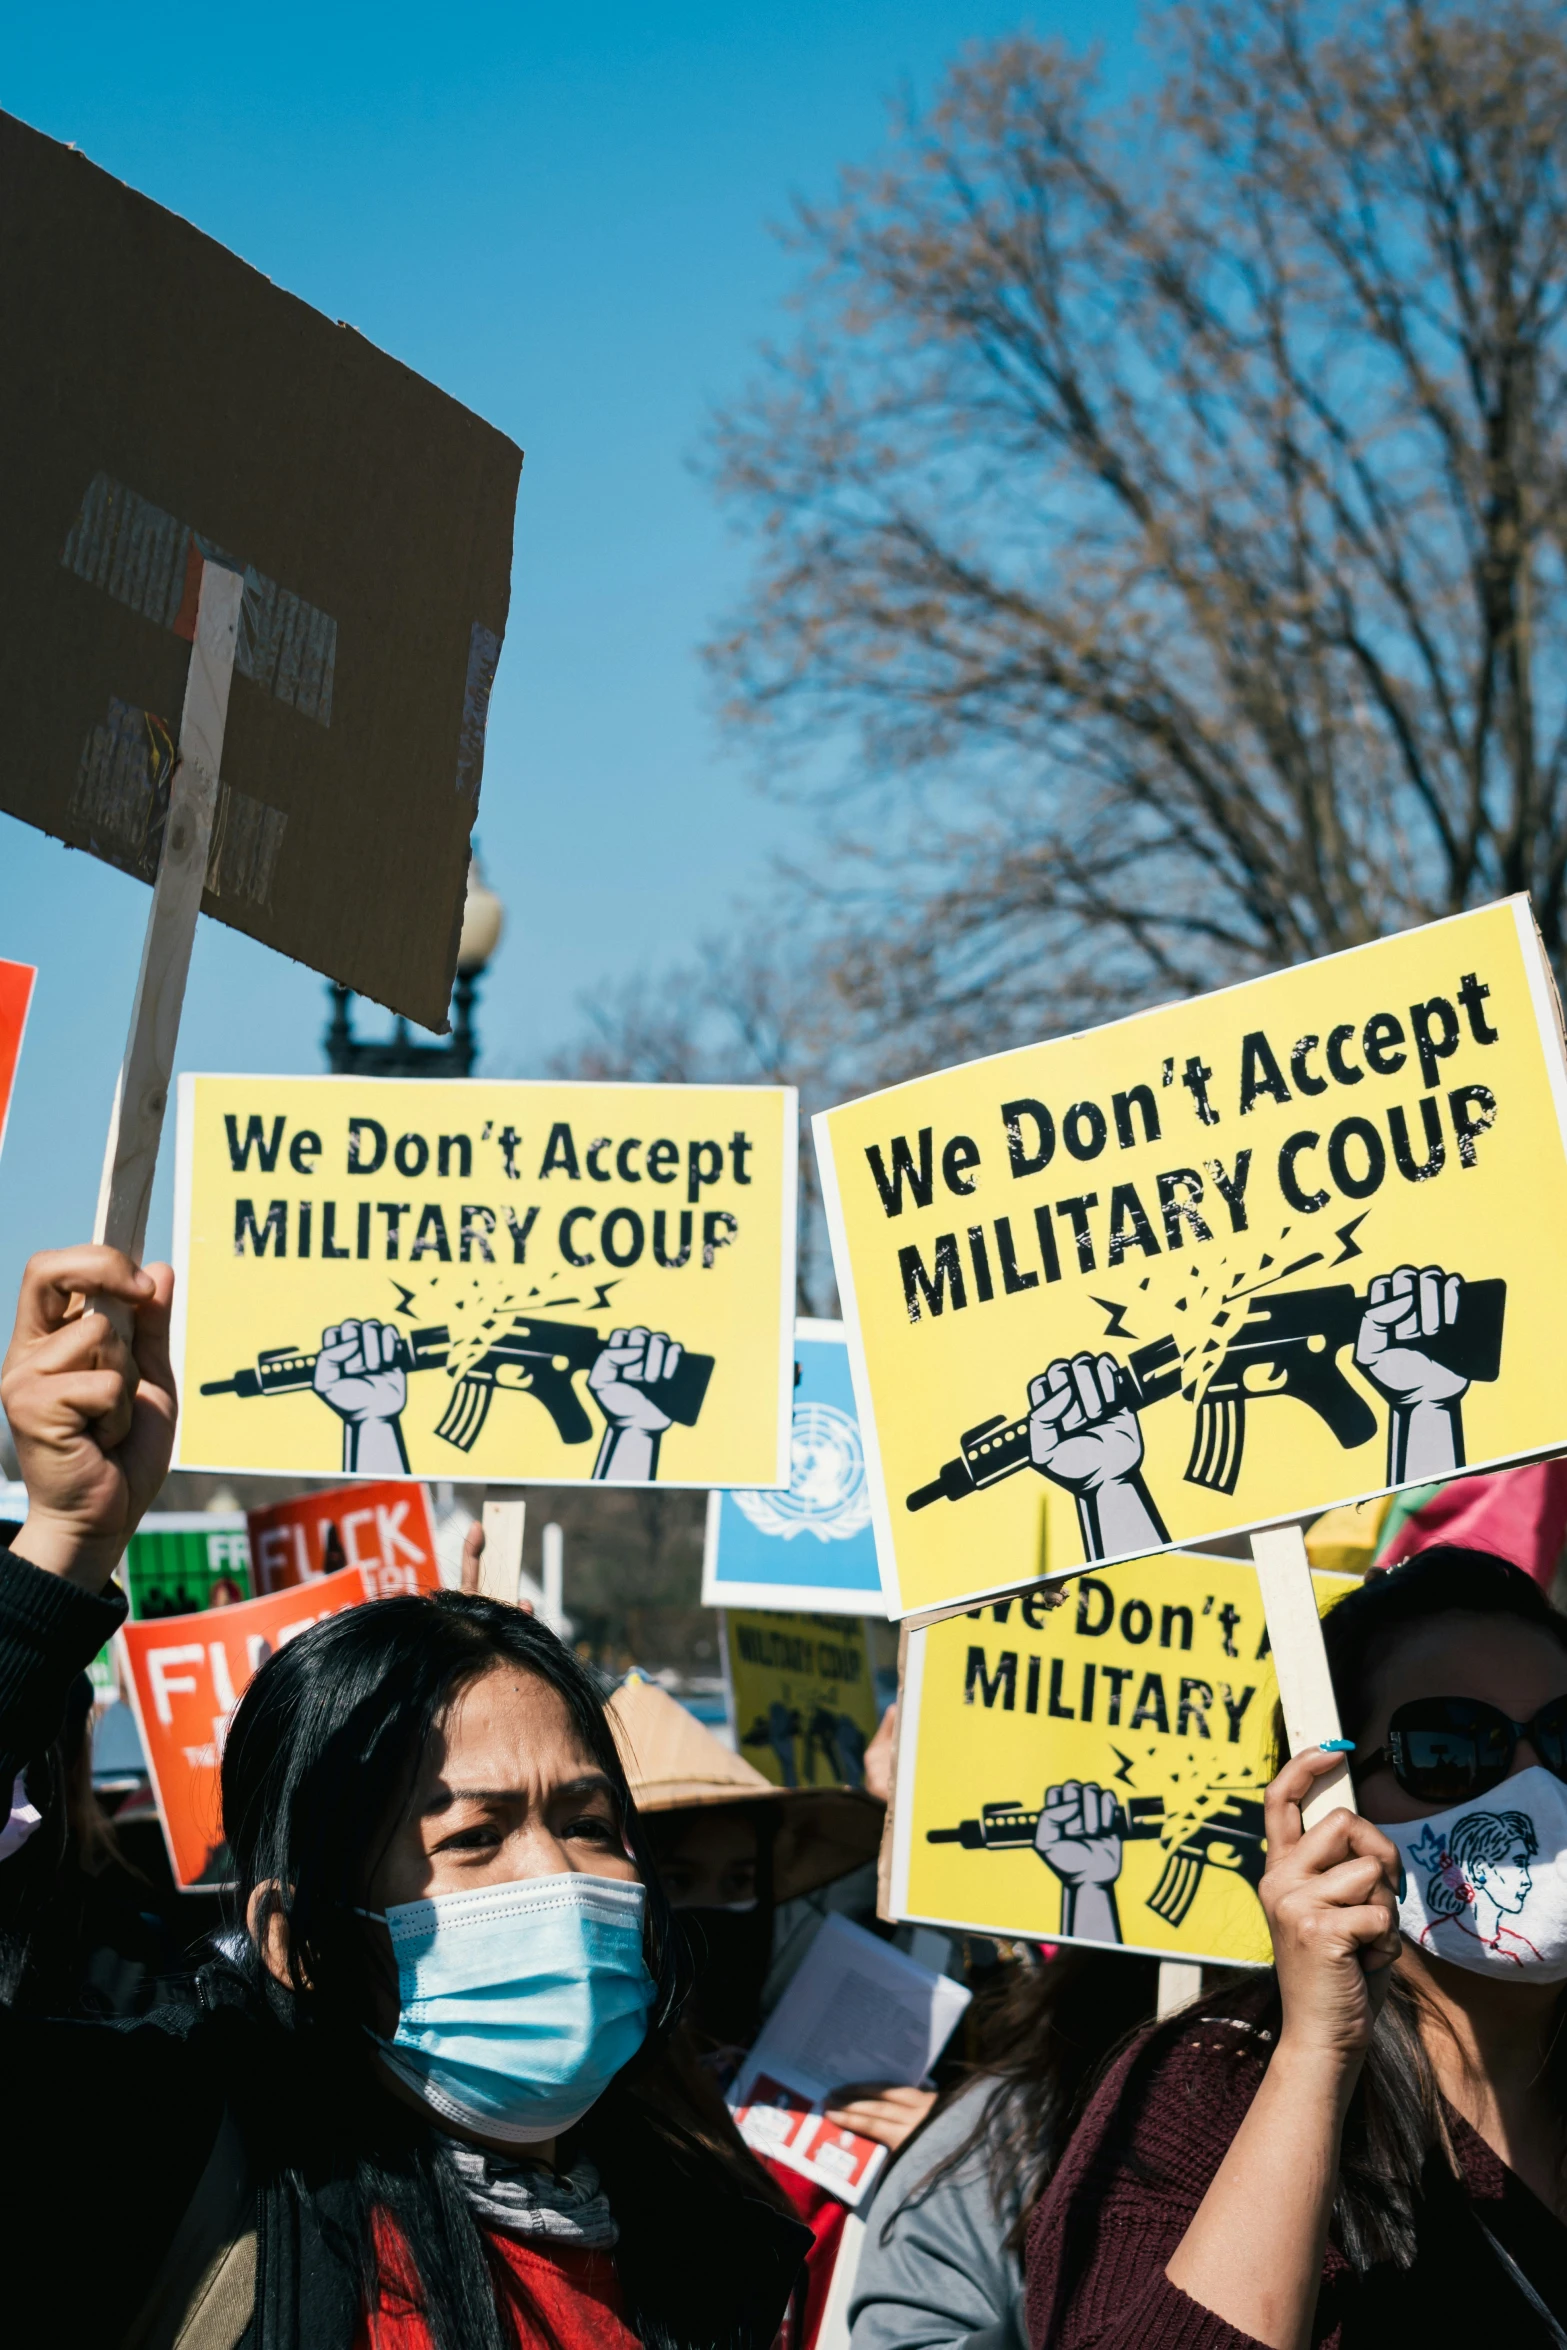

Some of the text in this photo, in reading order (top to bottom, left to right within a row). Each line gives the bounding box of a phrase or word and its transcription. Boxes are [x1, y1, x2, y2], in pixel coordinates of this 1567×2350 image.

[864, 972, 1499, 1219] We Don't Accept
[224, 1114, 753, 1204] We Don't Accept
[897, 1084, 1497, 1324] MILITARY COUP
[234, 1199, 738, 1269] MILITARY COUP
[259, 1500, 427, 1597] FUCK
[1075, 1576, 1241, 1658] Don't
[964, 1645, 1256, 1744] MILITARY
